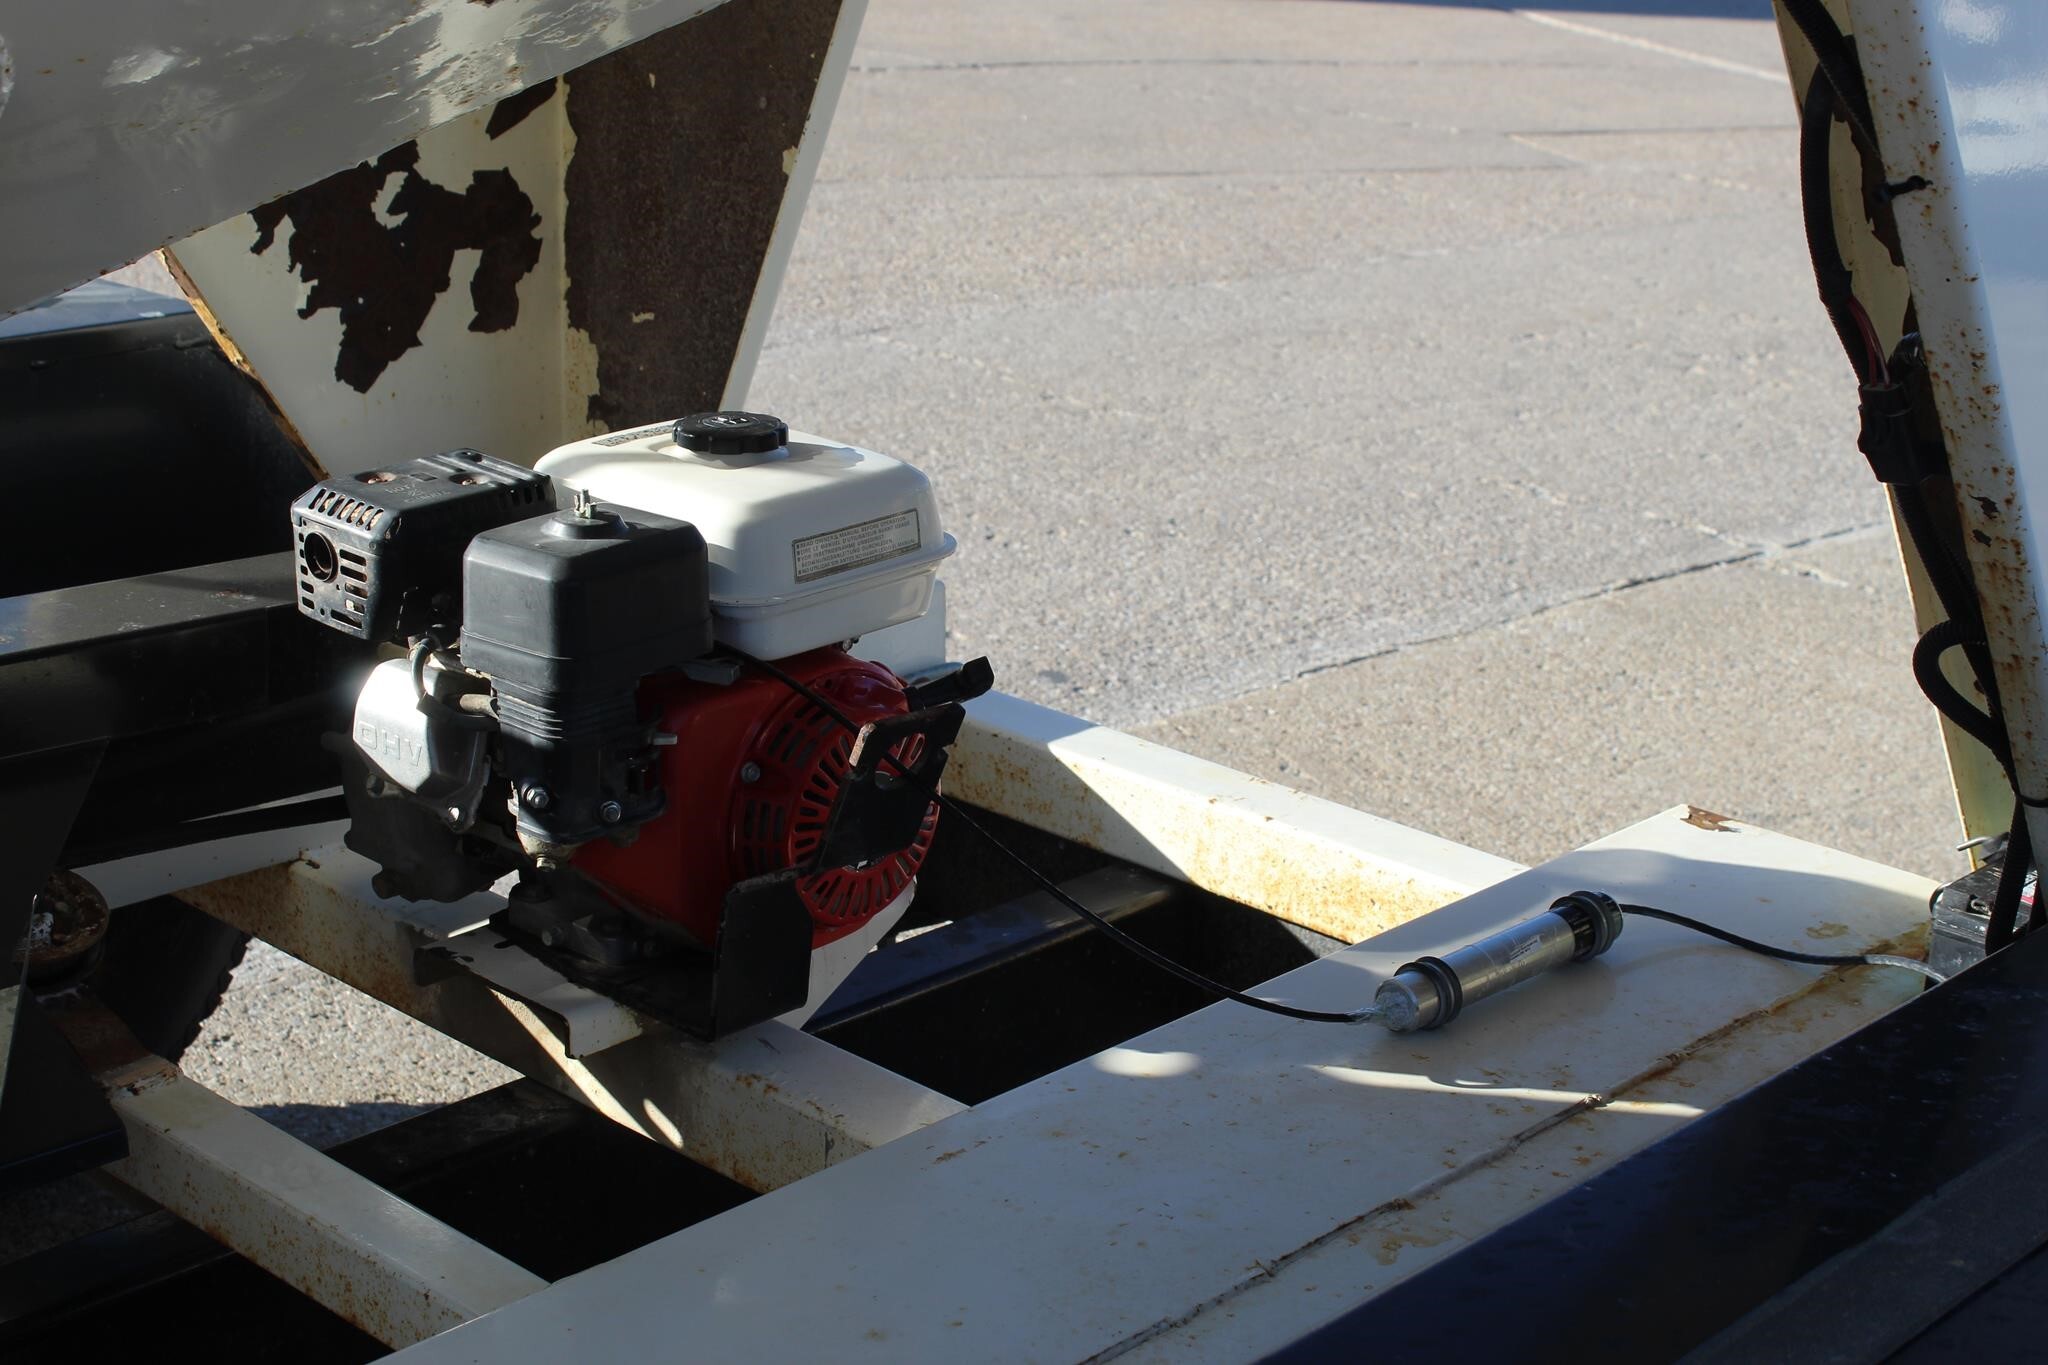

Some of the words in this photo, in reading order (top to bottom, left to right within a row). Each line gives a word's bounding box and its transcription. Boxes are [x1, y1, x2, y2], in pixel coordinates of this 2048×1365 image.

[799, 540, 813, 548] READ
[860, 522, 879, 532] BEFORE
[359, 721, 422, 767] OHV
